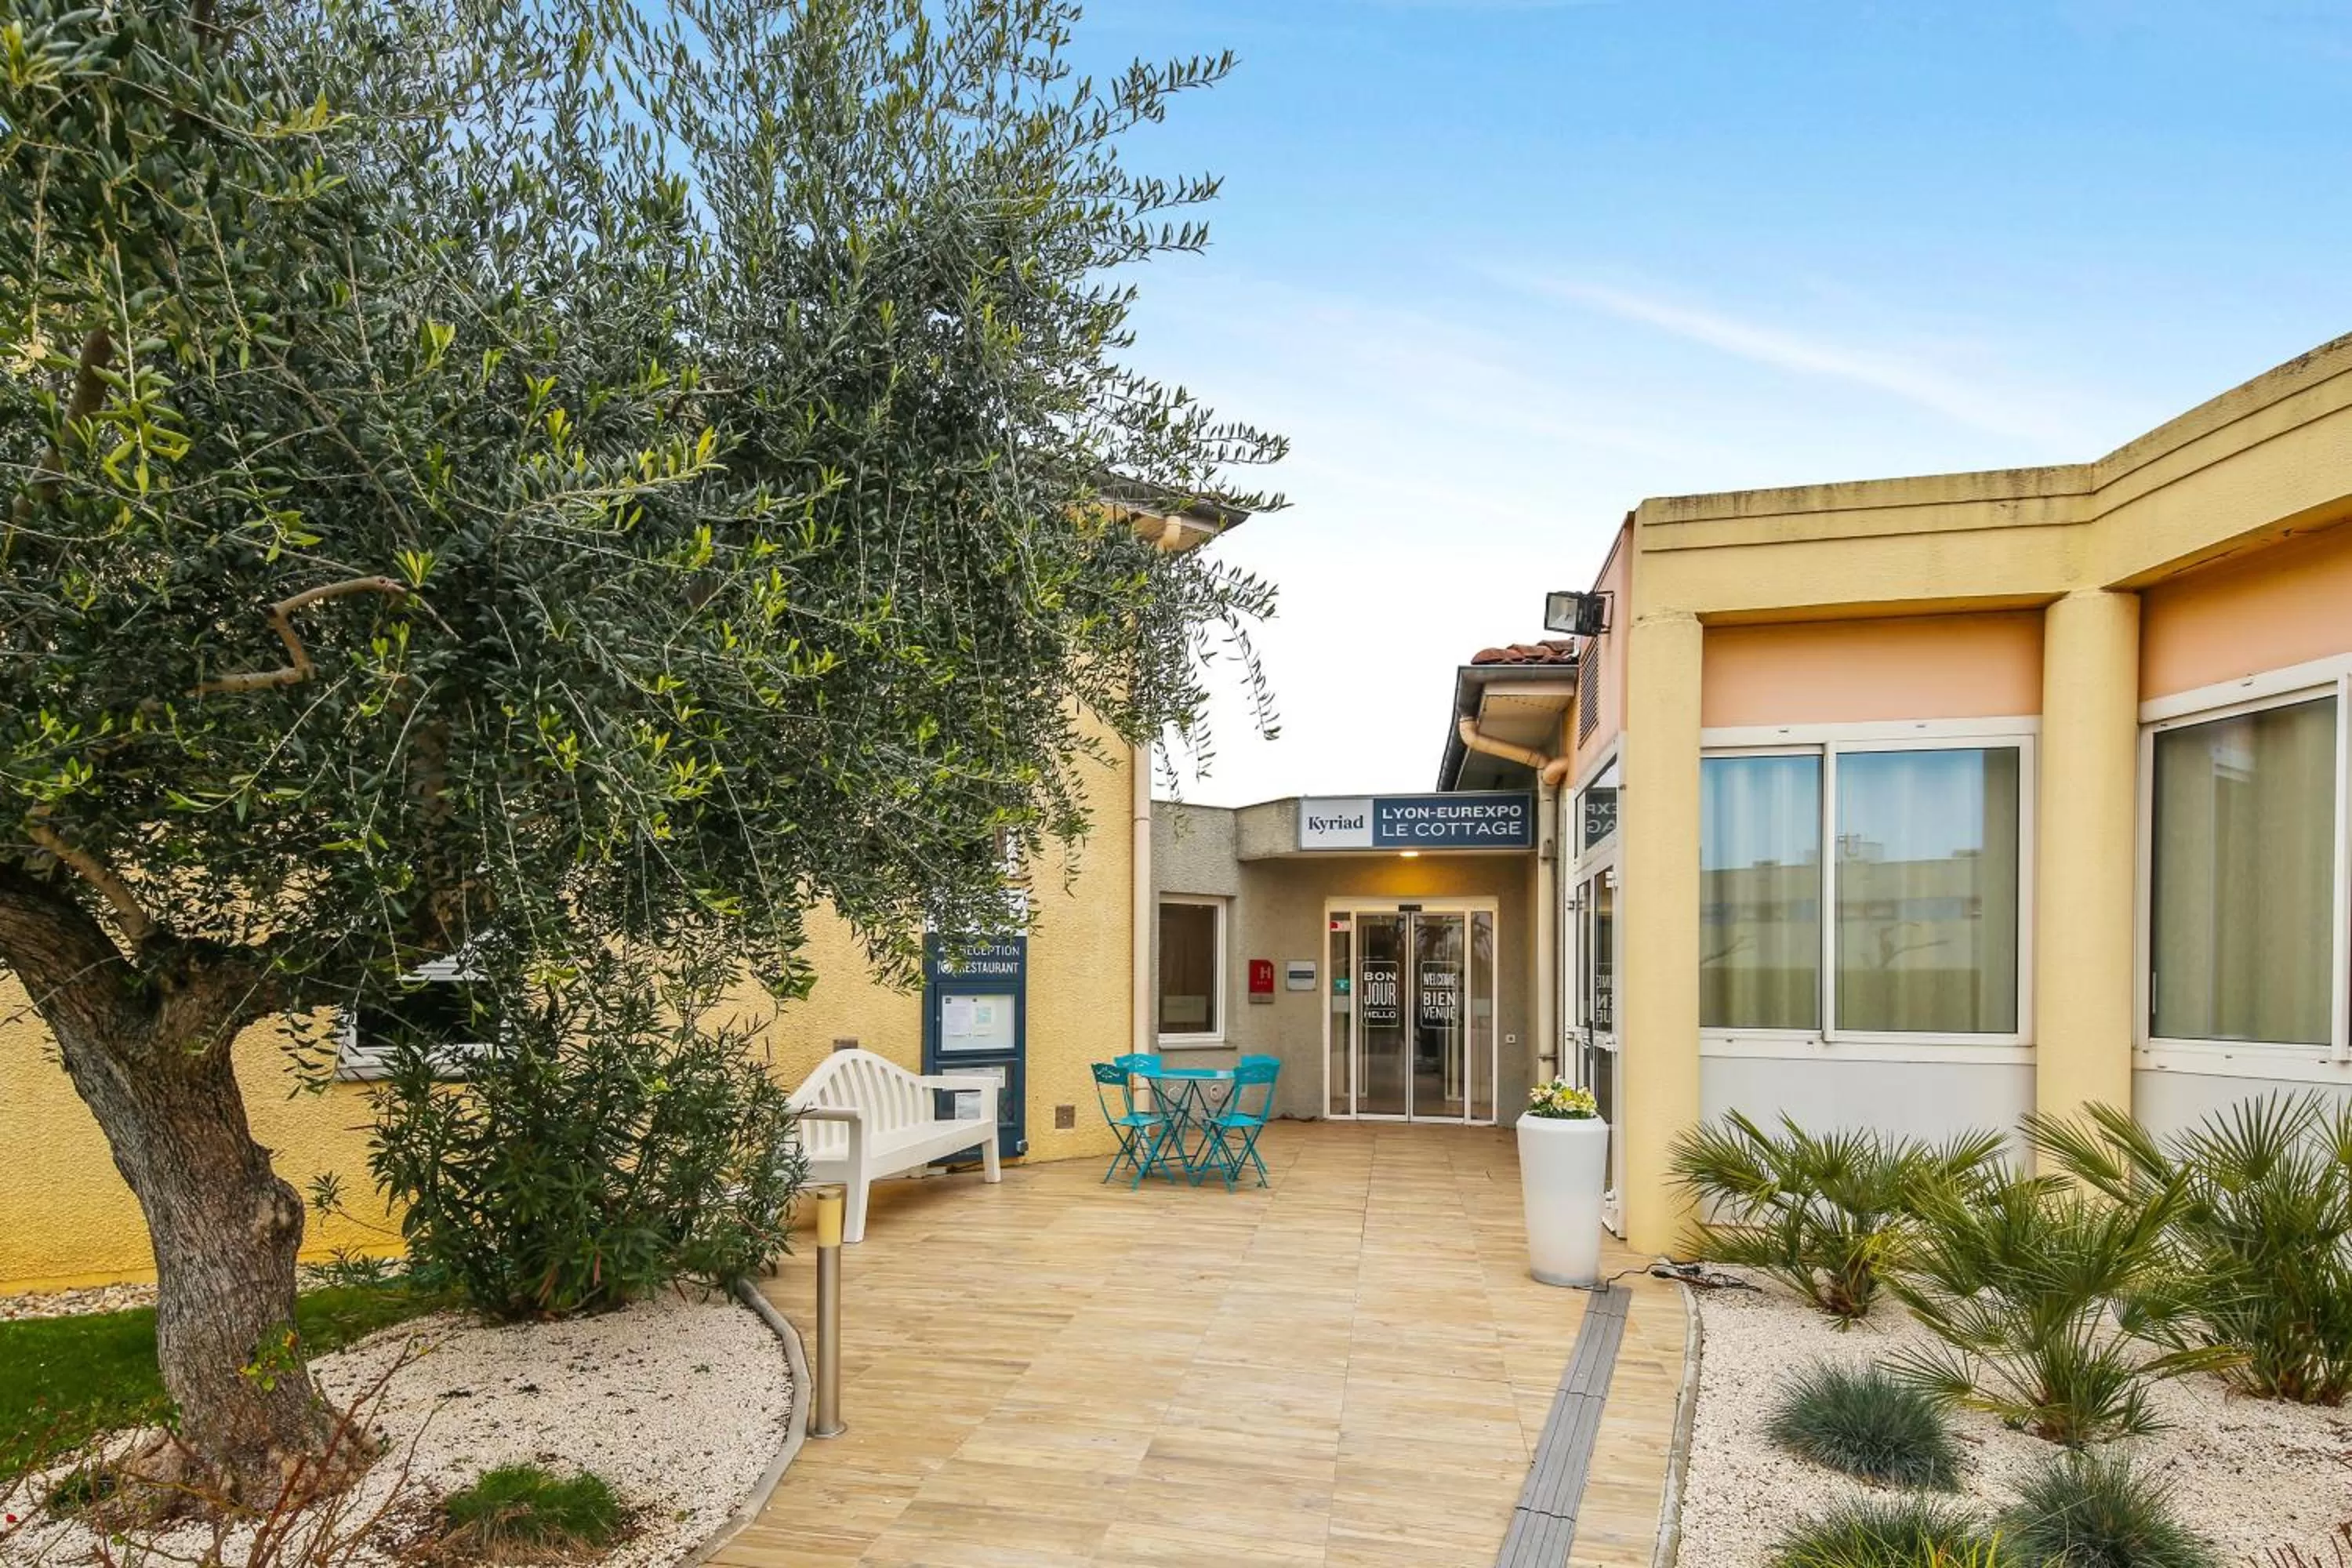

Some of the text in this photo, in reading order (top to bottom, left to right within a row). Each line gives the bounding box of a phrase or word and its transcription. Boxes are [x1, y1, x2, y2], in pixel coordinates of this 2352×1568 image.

[1381, 805, 1522, 819] LYON-EUREXPO
[1308, 815, 1364, 834] Kyriad
[1381, 821, 1522, 837] LE COTTAGE
[1363, 971, 1396, 981] BON
[1423, 973, 1456, 986] WELCOME
[1363, 982, 1396, 1006] JOUR
[1423, 992, 1456, 1006] BIEN
[1423, 1006, 1456, 1019] VENUE
